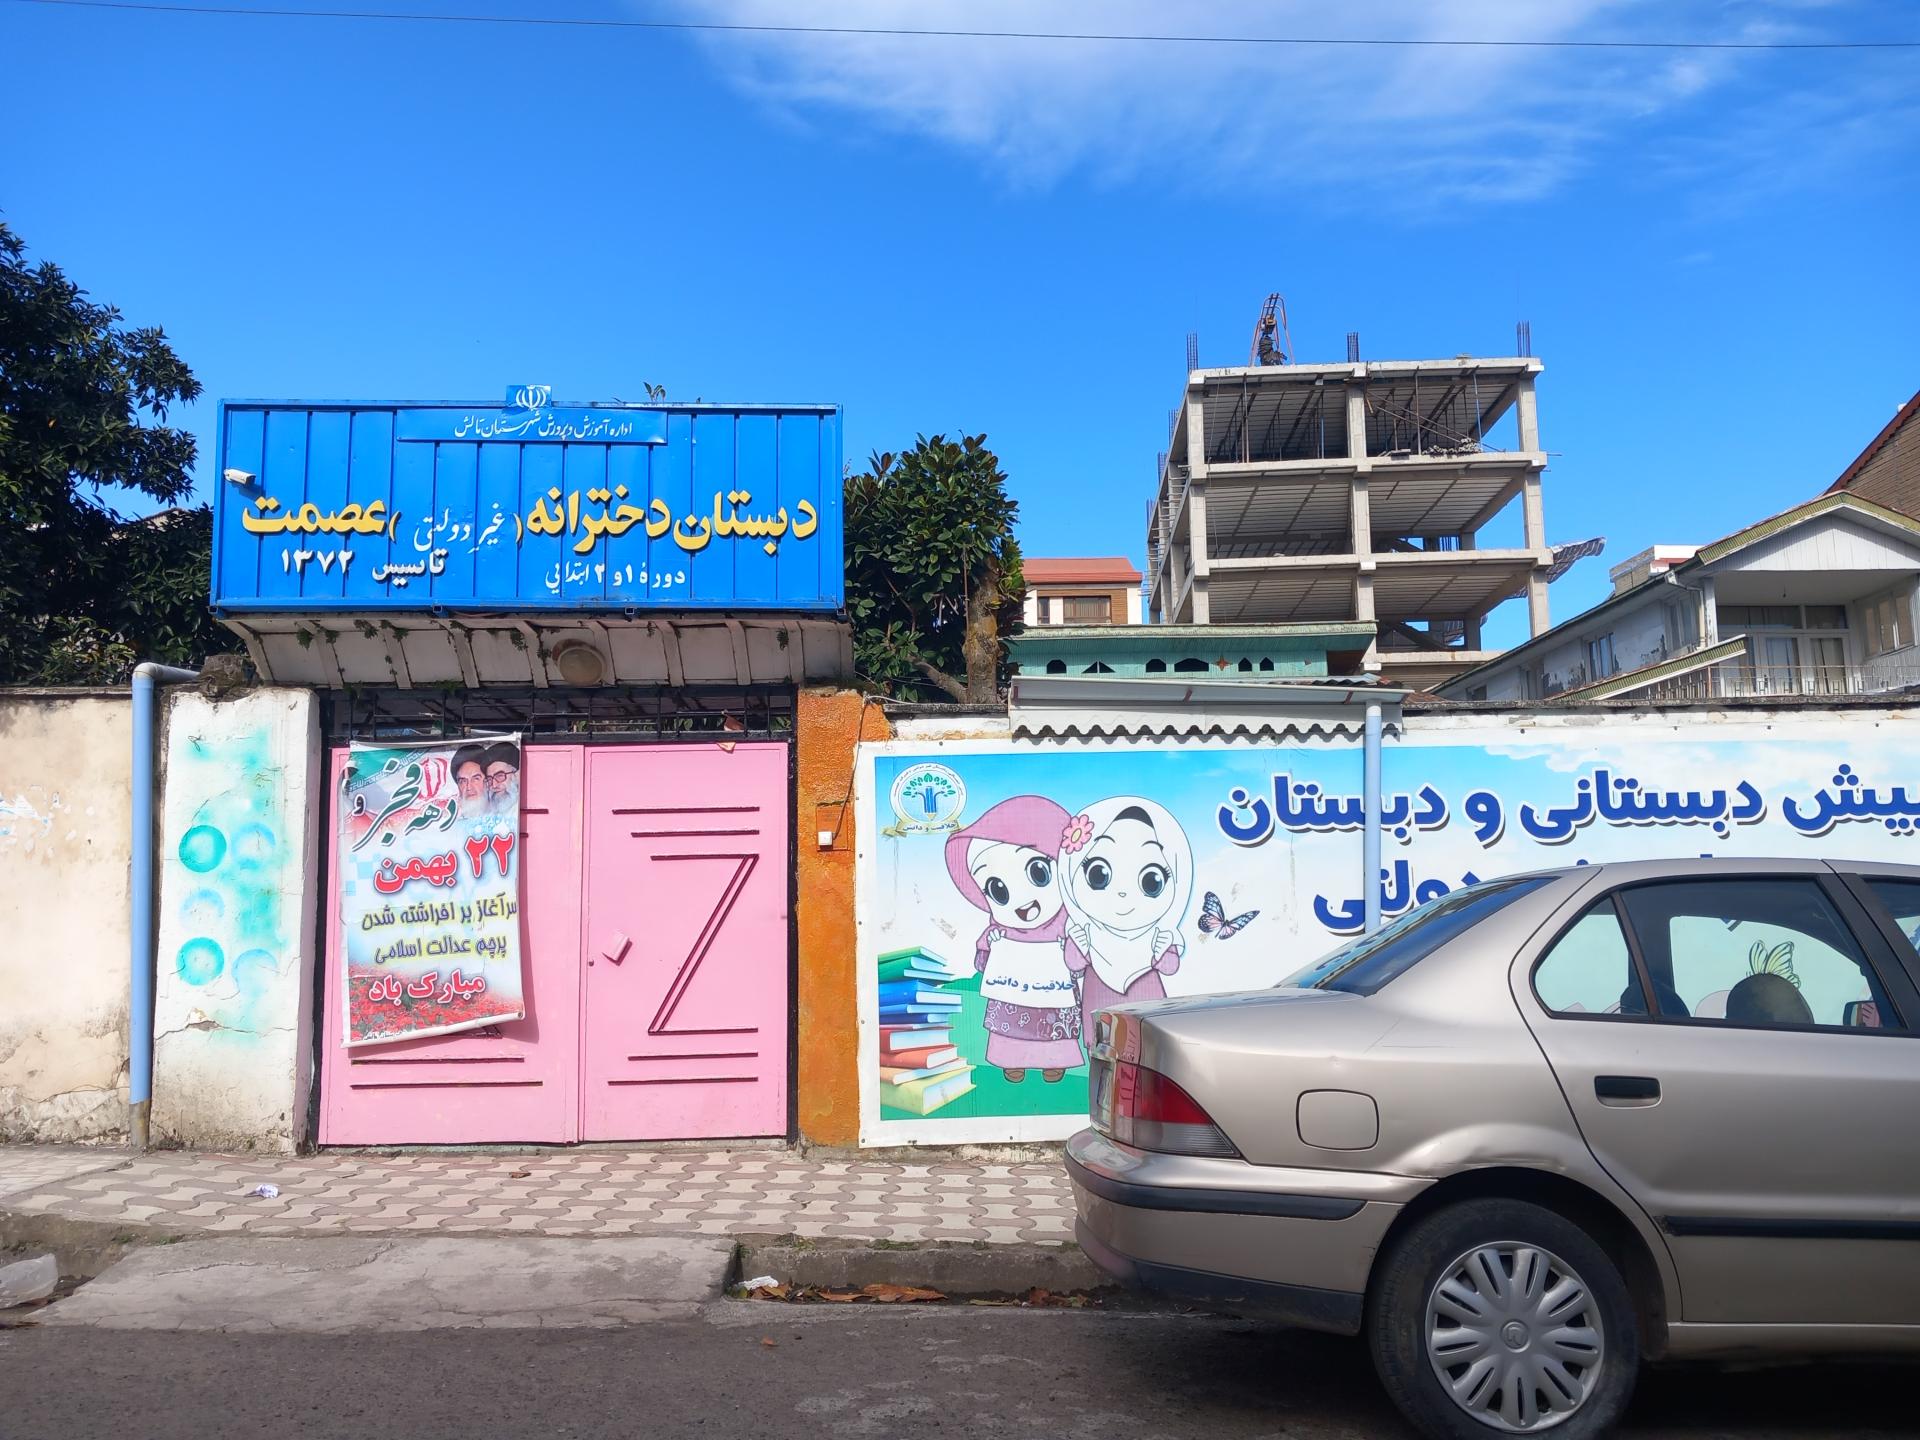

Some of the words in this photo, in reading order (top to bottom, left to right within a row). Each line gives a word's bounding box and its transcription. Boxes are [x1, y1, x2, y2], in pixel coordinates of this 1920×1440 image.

[454, 414, 484, 438] تالش
[481, 409, 541, 438] شهرستان
[538, 413, 567, 441] پرورش
[574, 414, 609, 439] آموزش
[609, 421, 633, 437] اداره
[242, 496, 386, 533] عصمت
[526, 483, 671, 553] دخترانه
[672, 489, 818, 555] دبستان
[281, 548, 353, 573] ۱۳۷۲
[352, 758, 423, 852] فجر
[404, 798, 459, 835] دهه
[1217, 774, 1448, 842] دبستان
[1464, 791, 1502, 843] و
[1520, 769, 1764, 840] دبستانی
[465, 833, 515, 877] ۲۲
[374, 851, 458, 893] بهمن
[361, 904, 396, 931] شدن
[400, 902, 456, 926] افراشته
[375, 938, 422, 963] اسلامی
[426, 934, 472, 956] عدالت
[476, 936, 507, 959] پرچم
[368, 975, 402, 1006] باد
[407, 968, 486, 1004] مبارک
[985, 976, 1019, 988] دانش
[1022, 983, 1029, 992] و
[1032, 978, 1075, 992] خلاقیت
